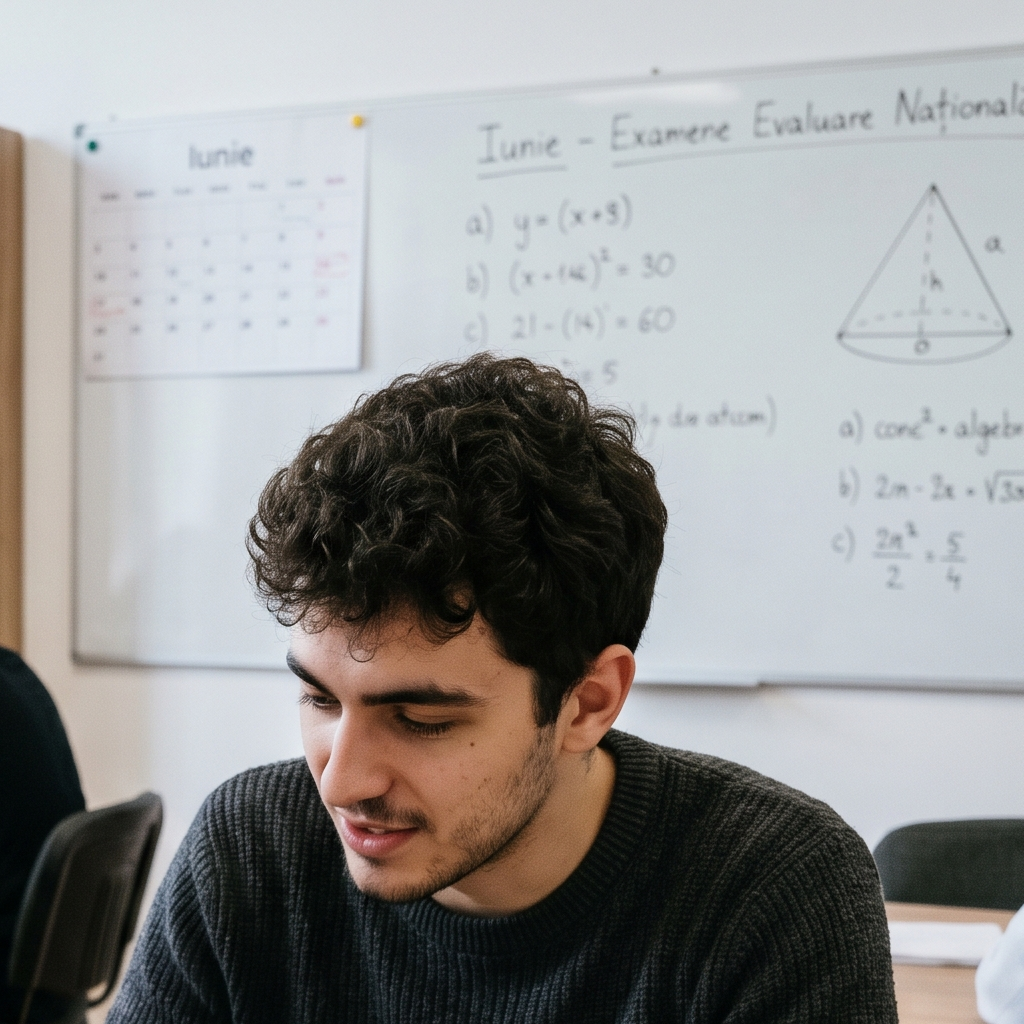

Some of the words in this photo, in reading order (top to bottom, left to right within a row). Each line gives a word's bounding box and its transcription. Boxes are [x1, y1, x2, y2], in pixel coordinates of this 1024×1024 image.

[477, 122, 562, 164] Iunie
[611, 112, 731, 151] Examene
[753, 99, 874, 138] Evaluare
[188, 141, 254, 169] Iunie
